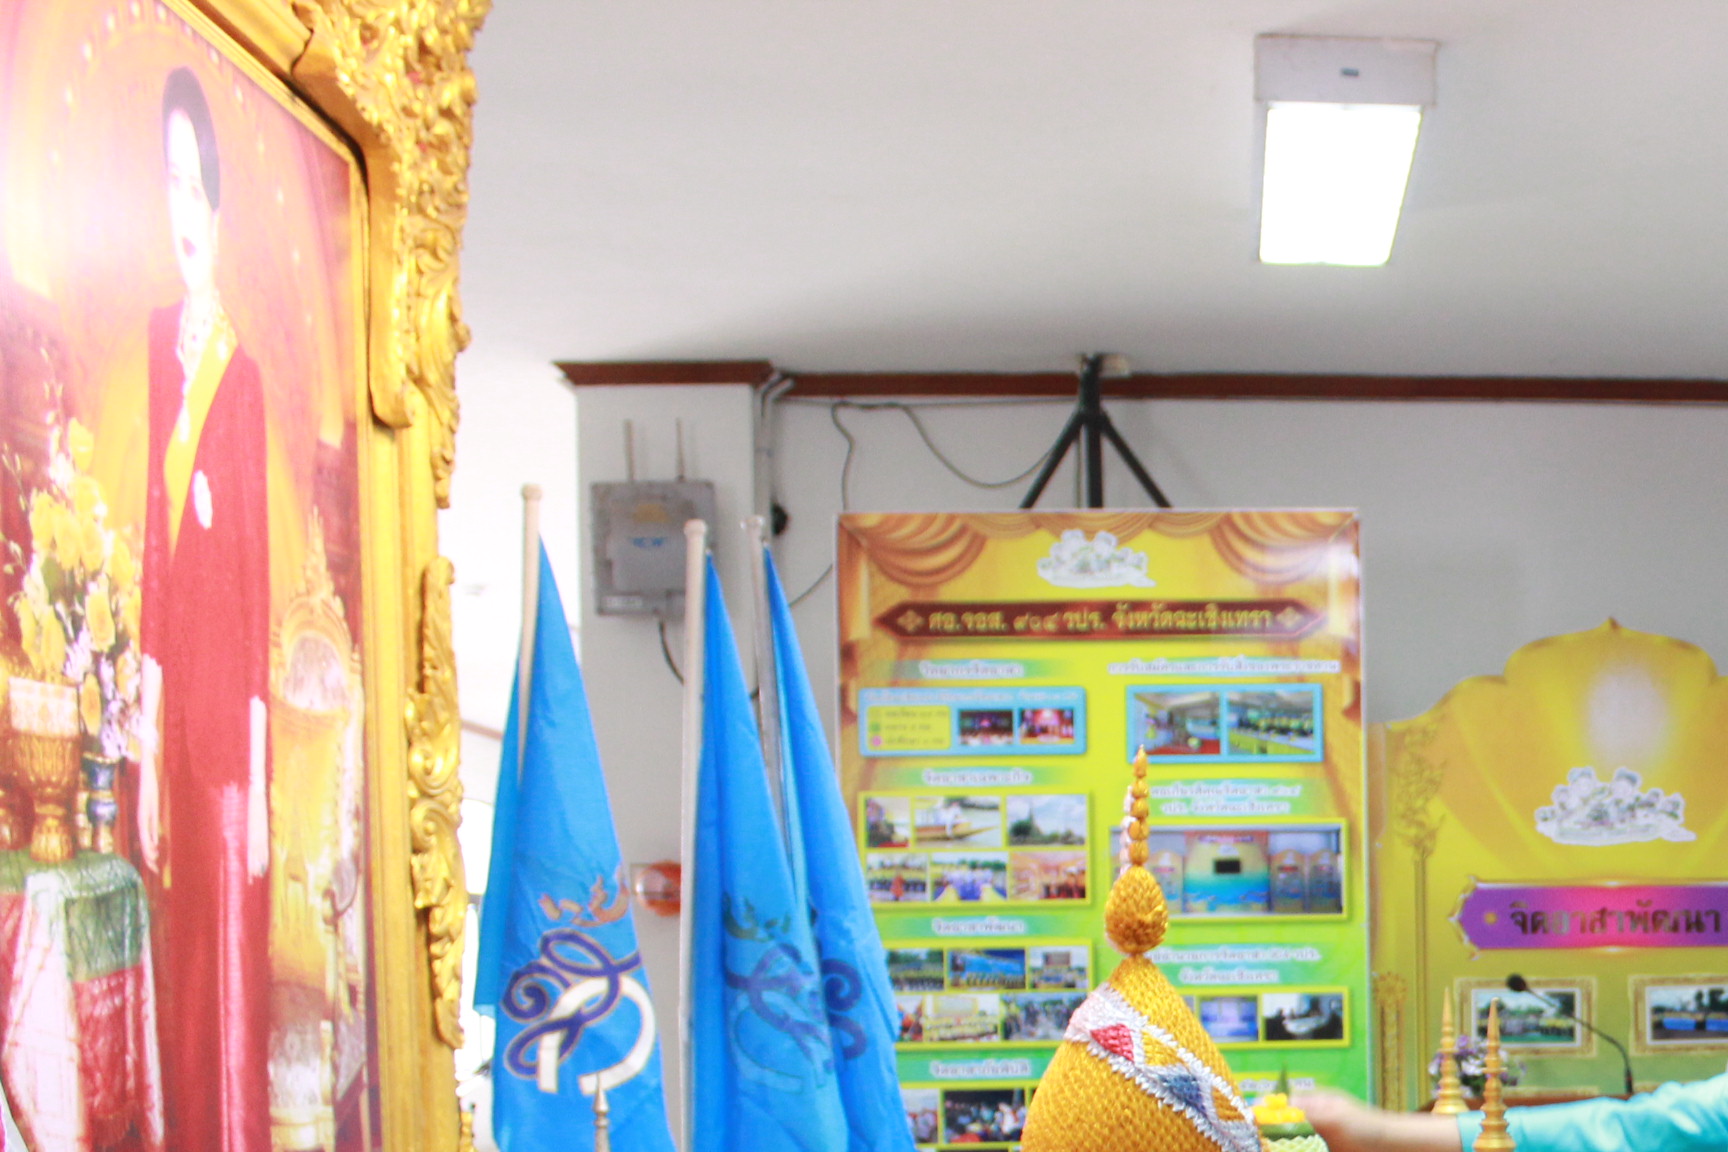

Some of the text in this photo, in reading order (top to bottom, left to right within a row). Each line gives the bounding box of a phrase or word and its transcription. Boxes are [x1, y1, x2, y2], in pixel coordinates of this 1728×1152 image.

[1509, 899, 1722, 935] จิตอาสาพัฒนา
